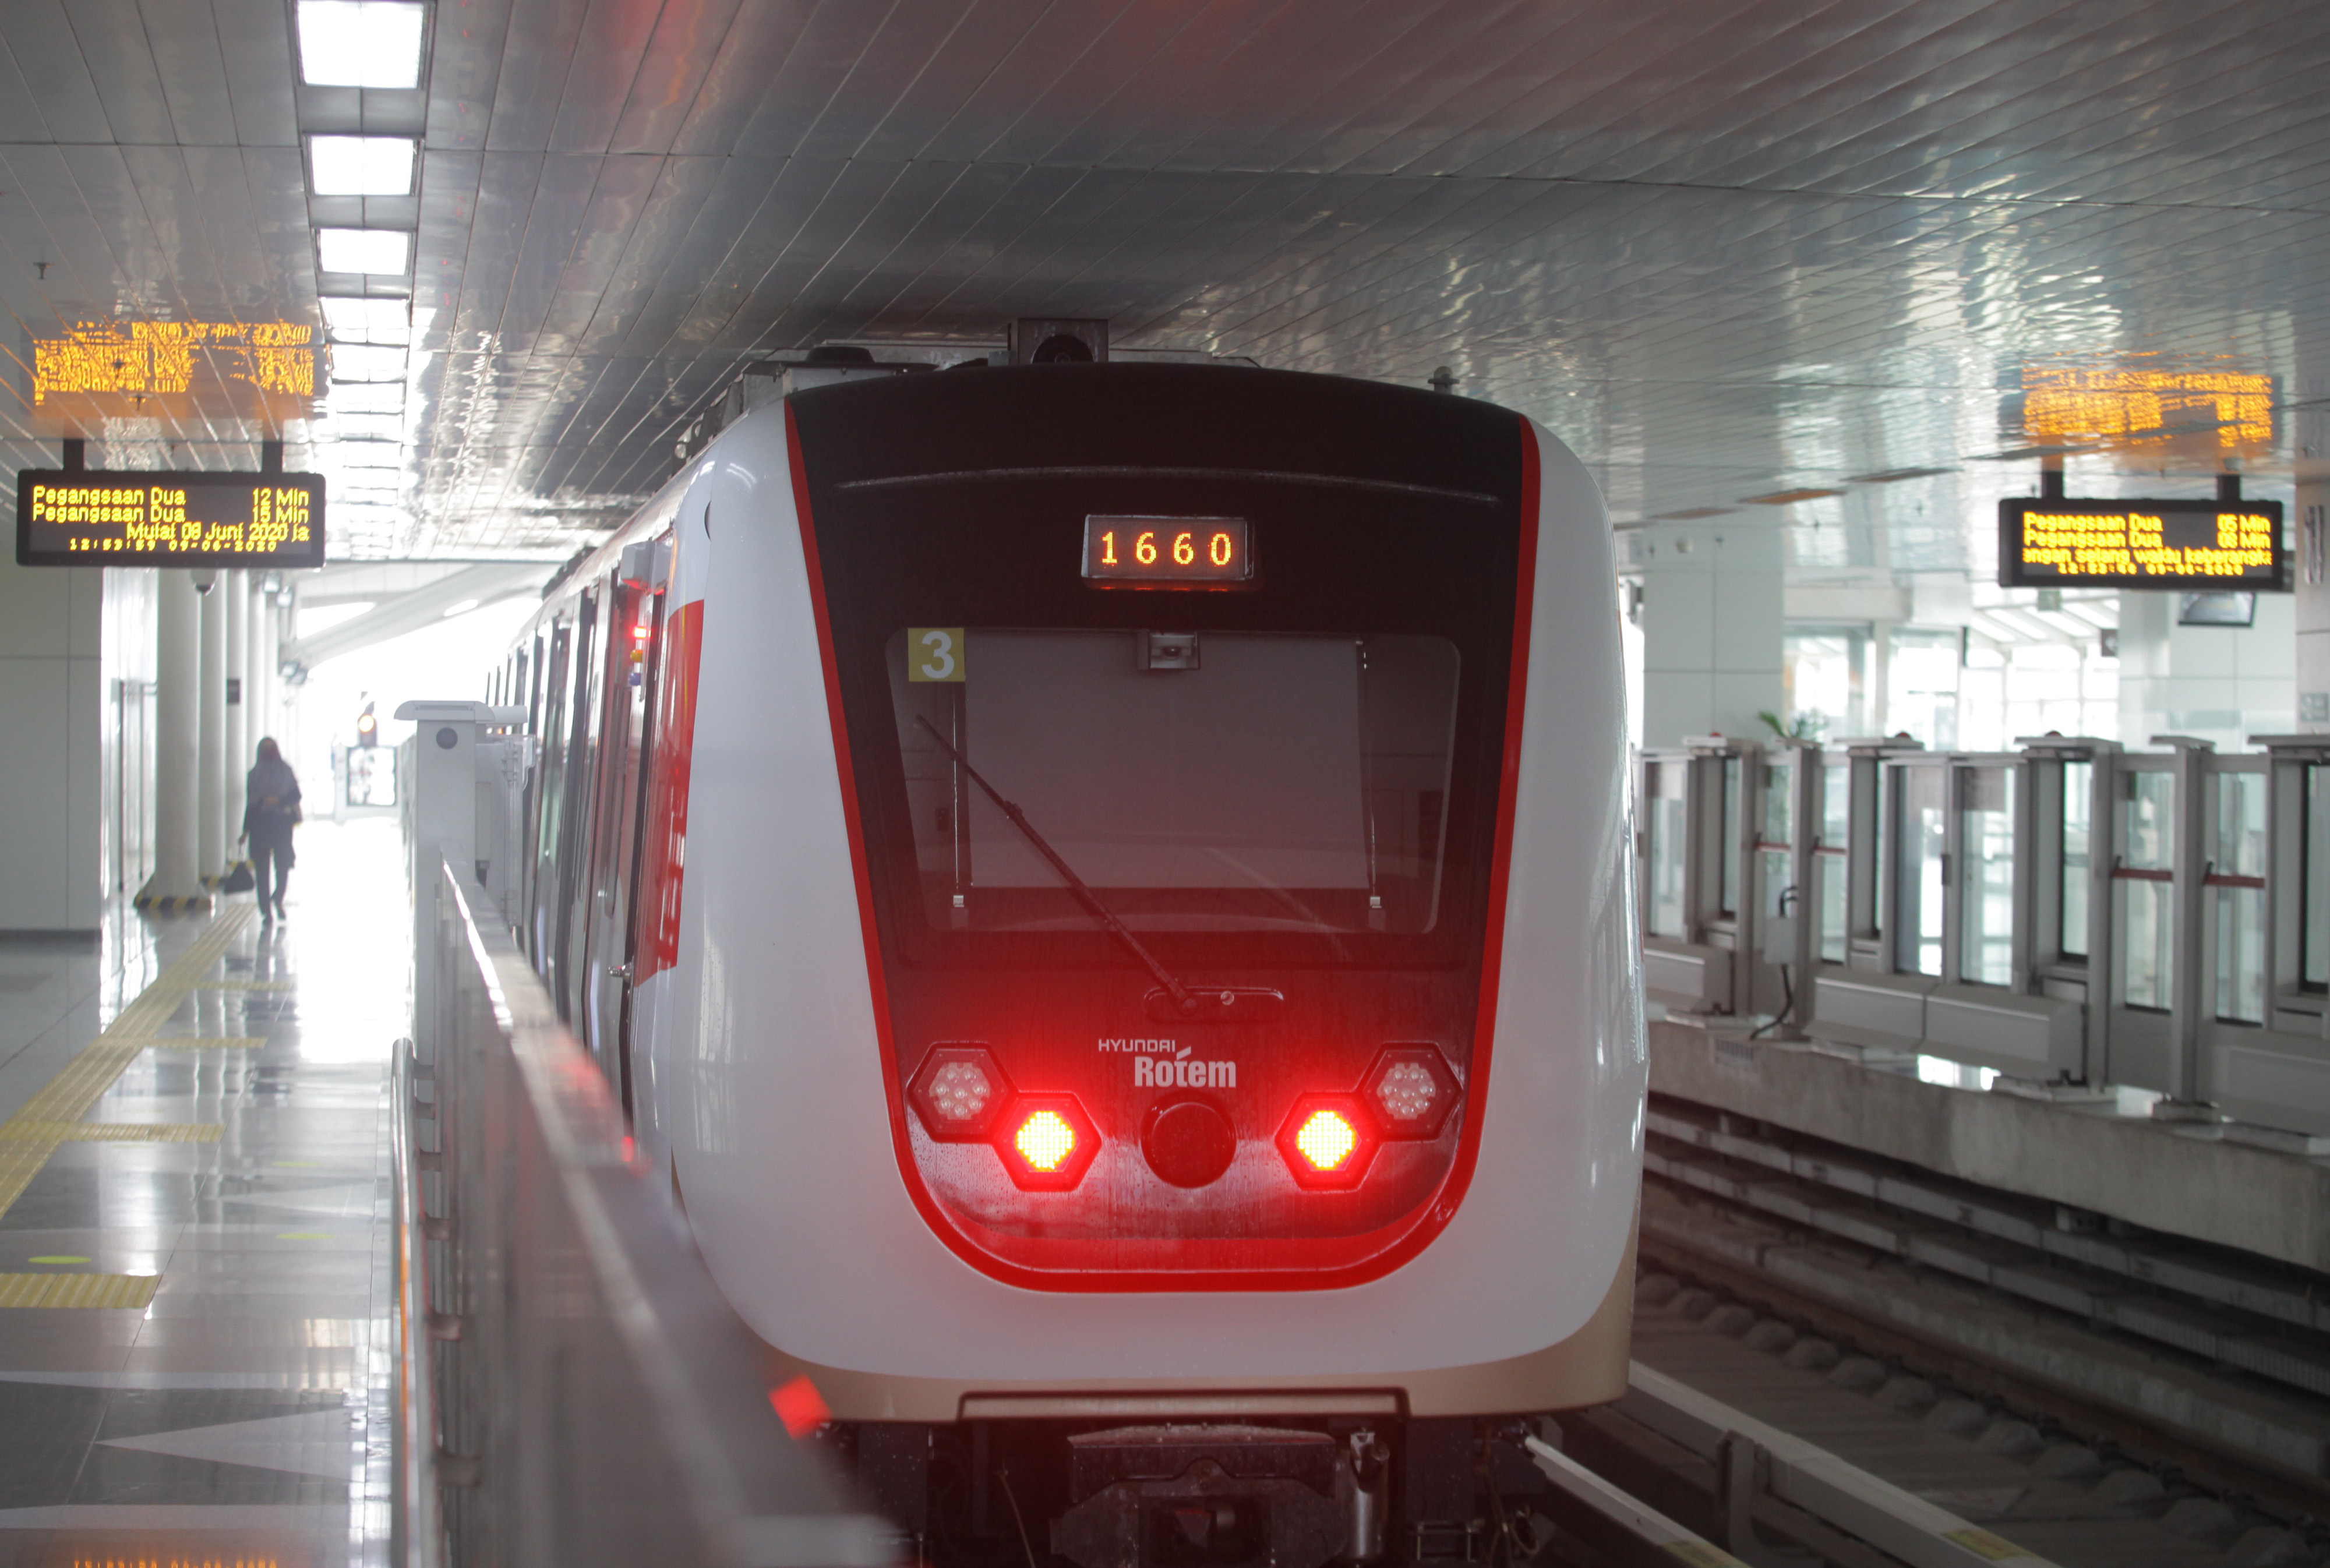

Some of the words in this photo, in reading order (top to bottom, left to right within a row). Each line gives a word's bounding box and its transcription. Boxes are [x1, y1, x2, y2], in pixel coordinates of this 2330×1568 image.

[33, 485, 144, 505] Pegangsaan
[150, 487, 186, 505] Dua
[252, 488, 271, 506] 12
[276, 488, 309, 506] Min
[33, 503, 144, 523] Pegangsaan
[150, 504, 186, 522] Dua
[252, 506, 271, 522] 15
[276, 506, 309, 523] Min
[2023, 511, 2126, 531] Pegangsaan
[2128, 513, 2163, 531] Dua
[2239, 514, 2271, 532] Min
[126, 522, 176, 540] Mulai
[181, 522, 201, 540] 08
[205, 522, 243, 541] Juni
[249, 522, 288, 541] 2020
[2023, 529, 2126, 548] Pegangsaan
[2128, 531, 2163, 548] Dua
[2239, 531, 2271, 549] Min
[2074, 546, 2130, 564] selang
[2133, 546, 2182, 564] waktu
[921, 631, 955, 679] 3
[1099, 1039, 1175, 1053] HYUNDAI
